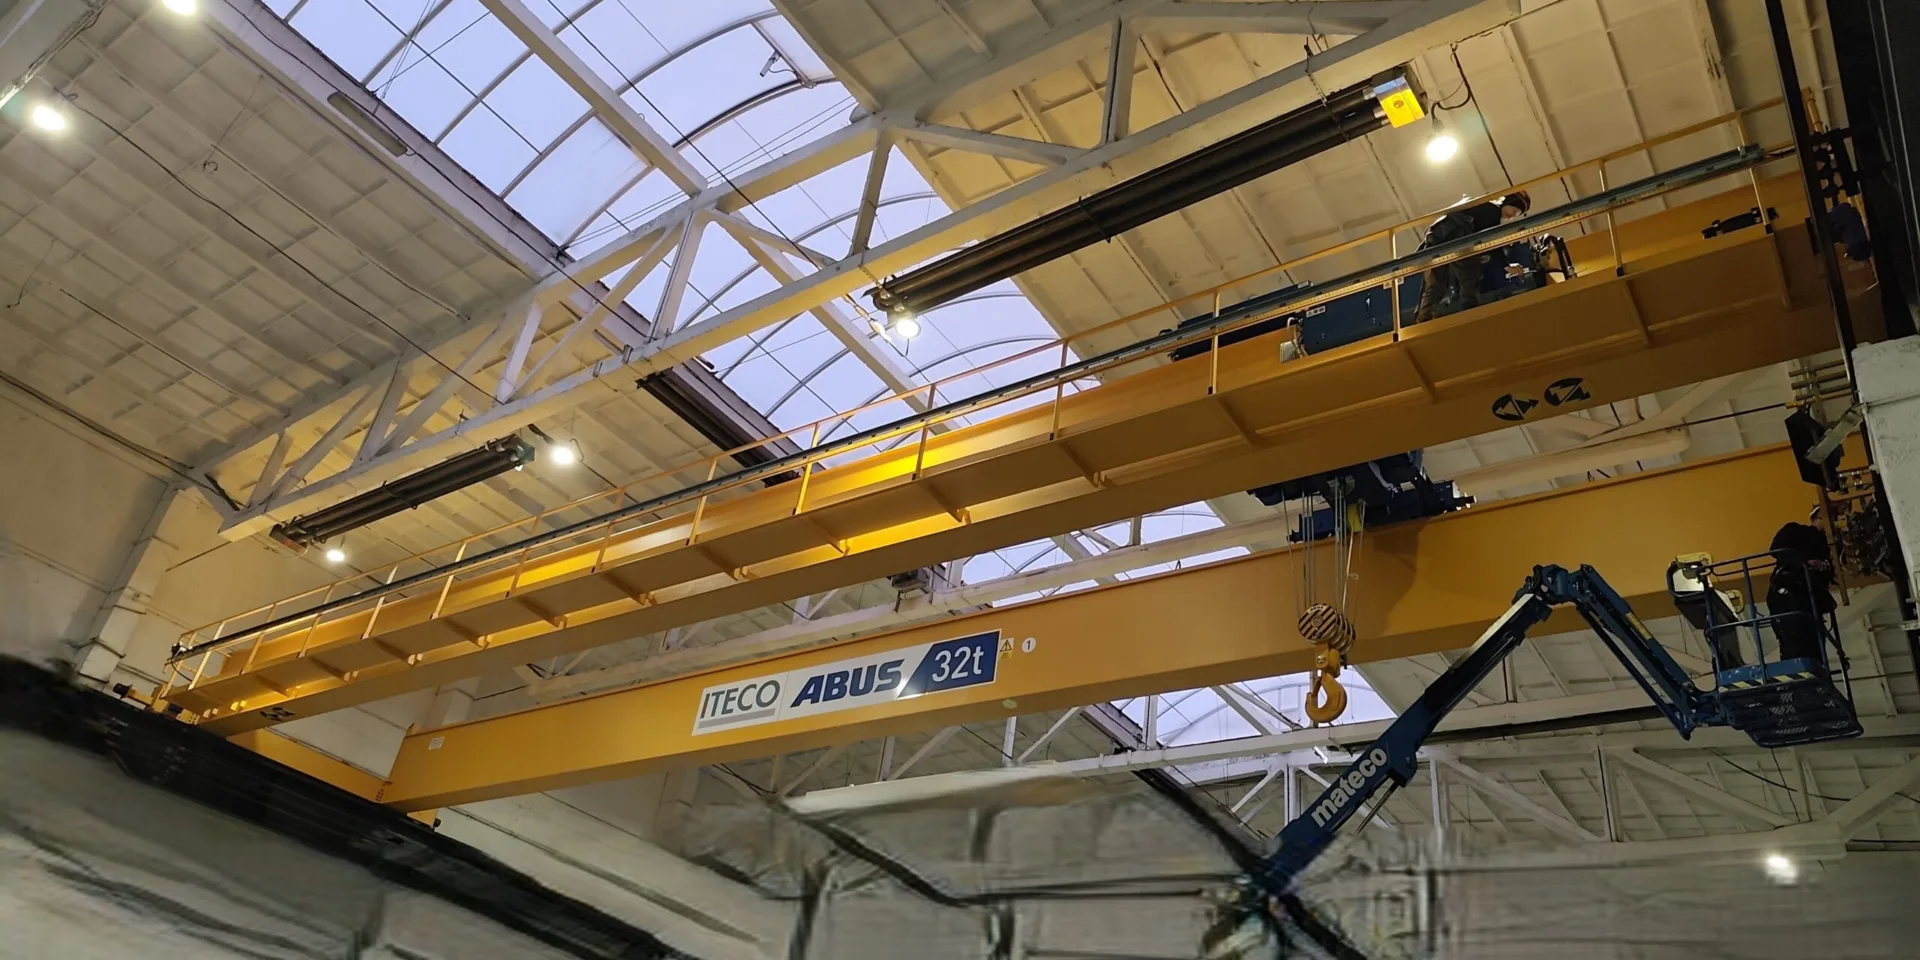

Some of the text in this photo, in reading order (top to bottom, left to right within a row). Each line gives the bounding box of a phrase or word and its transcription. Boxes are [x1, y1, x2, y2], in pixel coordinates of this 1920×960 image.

[700, 680, 780, 719] ITECO
[790, 646, 984, 708] ABUS 32t
[1311, 748, 1387, 828] mateco
